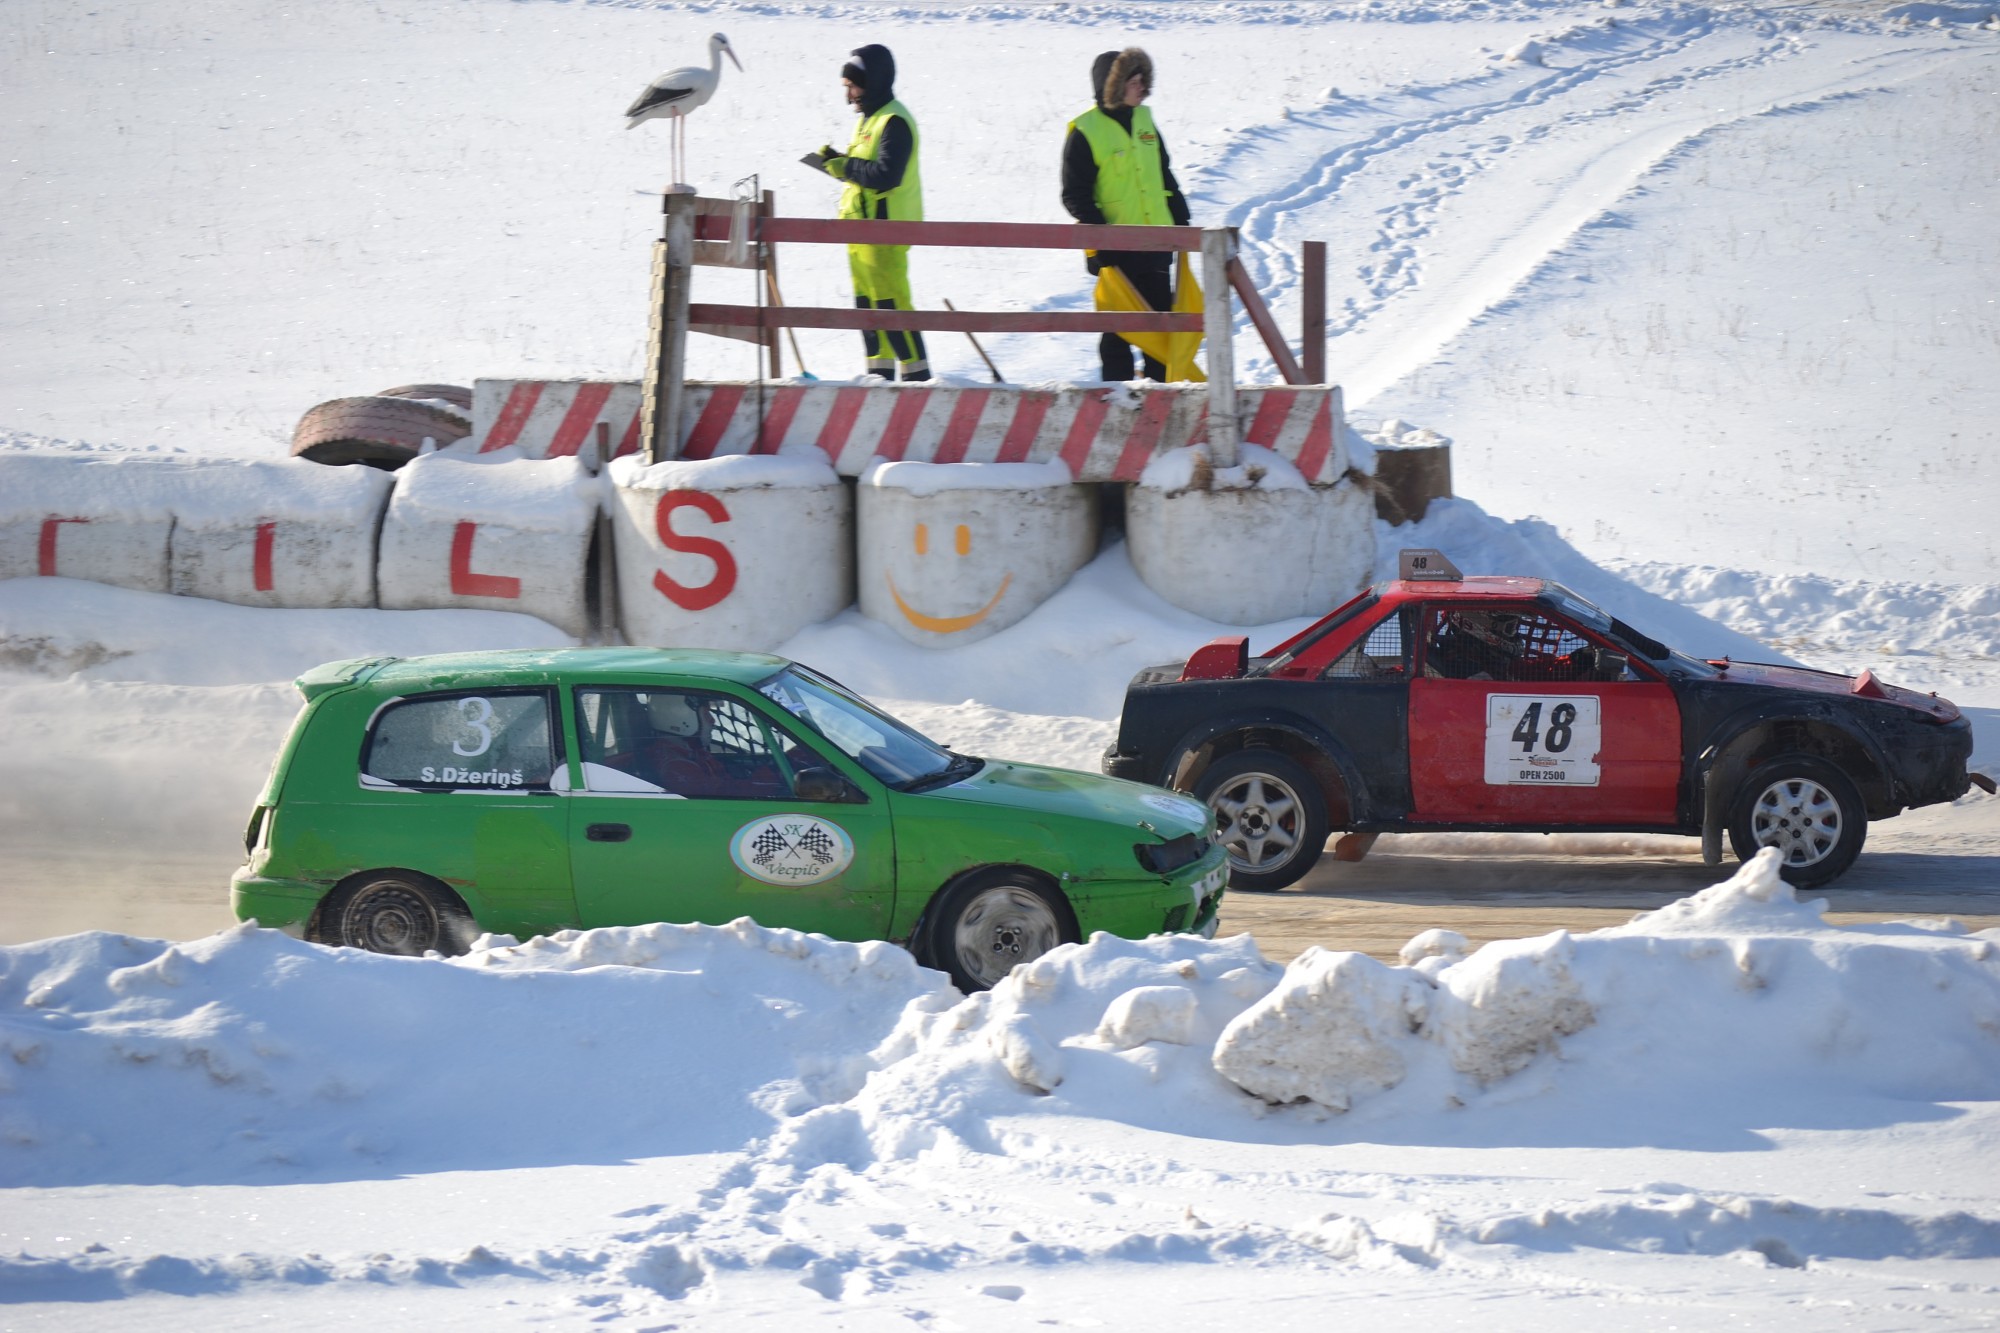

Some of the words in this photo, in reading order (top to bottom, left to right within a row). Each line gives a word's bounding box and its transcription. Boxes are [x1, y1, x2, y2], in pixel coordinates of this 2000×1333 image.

[1412, 557, 1427, 569] 48
[453, 696, 492, 757] 3
[1511, 702, 1577, 753] 48
[420, 766, 524, 789] S.Džeriņš
[1519, 770, 1541, 780] OPEN
[1543, 770, 1566, 780] 2500
[781, 824, 804, 837] SK
[766, 862, 821, 879] Vecpils
